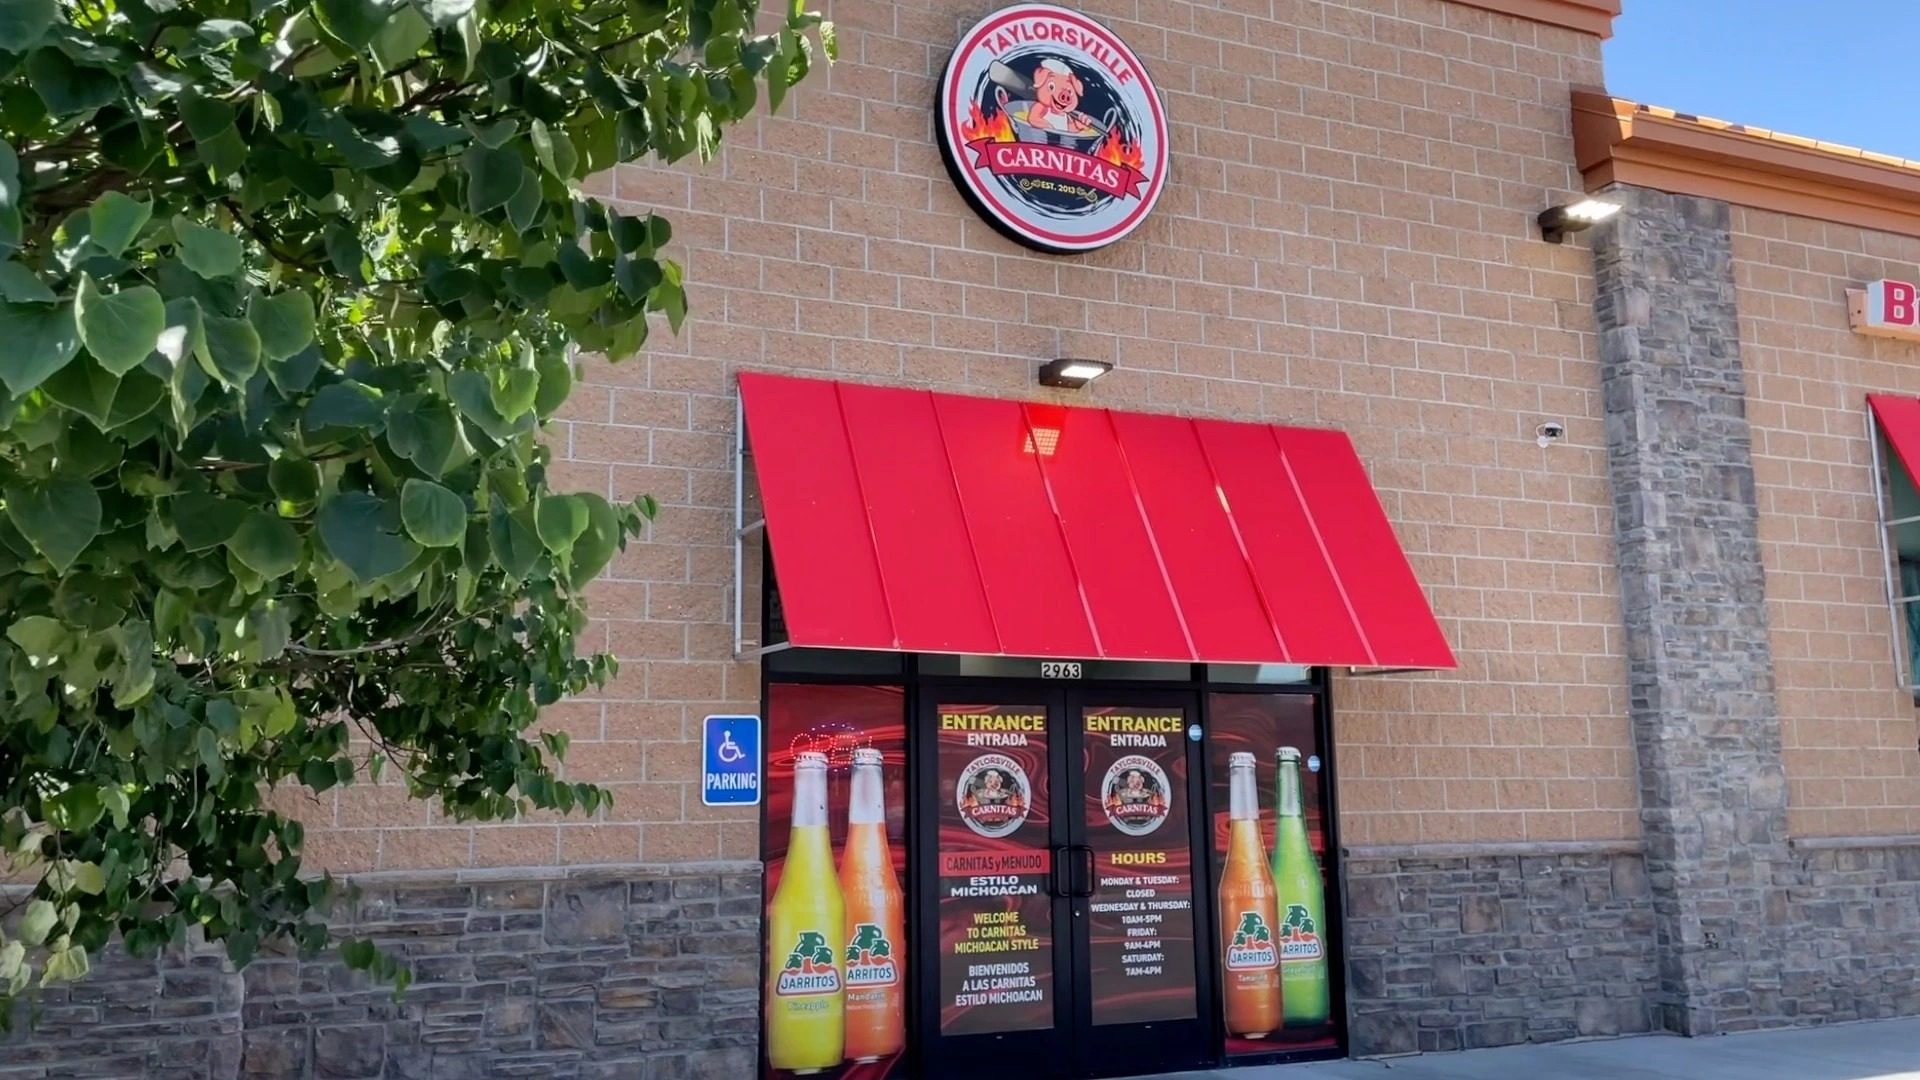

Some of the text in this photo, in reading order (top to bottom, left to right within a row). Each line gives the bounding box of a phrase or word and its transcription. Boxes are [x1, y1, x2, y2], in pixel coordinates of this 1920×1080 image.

[981, 22, 1132, 86] TAYLORSVILLE
[996, 147, 1120, 188] CARNITAS
[1041, 181, 1076, 194] EST. 2013
[1882, 278, 1920, 327] B
[1042, 663, 1081, 679] 2963
[942, 714, 1044, 731] ENTRANCE
[1086, 716, 1182, 732] ENTRANCE
[967, 733, 1028, 746] ENTRADA
[1110, 734, 1167, 747] ENTRADA
[966, 757, 1021, 774] TAYLORSVILLE
[1110, 757, 1161, 774] TAYLORSVILLE
[707, 772, 757, 790] PARKING
[971, 804, 1017, 816] CARNITAS
[1115, 803, 1159, 815] CARNITAS
[946, 857, 994, 871] CARNITAS
[1002, 855, 1042, 869] MENUDO
[1111, 852, 1166, 865] HOURS
[970, 875, 1019, 887] ESTILO
[1100, 875, 1180, 887] MONDAY & TUESDAY:
[951, 884, 1037, 897] MICHOACAN
[1125, 889, 1156, 898] CLOSED
[1091, 900, 1191, 912] WEDNESDAY & THURSDAY:
[973, 912, 1019, 924] WELCOME
[1121, 914, 1162, 924] 10AM-5PM
[967, 925, 1027, 939] TO CARNITAS
[1126, 927, 1157, 937] FRIDAY:
[954, 938, 1039, 954] MICHOACAN STYLE
[1282, 943, 1318, 954] ARRITOS
[1121, 953, 1165, 963] SATURDAY:
[1231, 951, 1273, 963] JARRITOS
[847, 967, 893, 981] ARRITOS
[968, 962, 1030, 977] BIENVENIDOS
[780, 975, 836, 990] JARRITOS
[962, 976, 1036, 992] A LAS CARNITAS
[955, 989, 1043, 1007] ESTILO MICHOACAN
